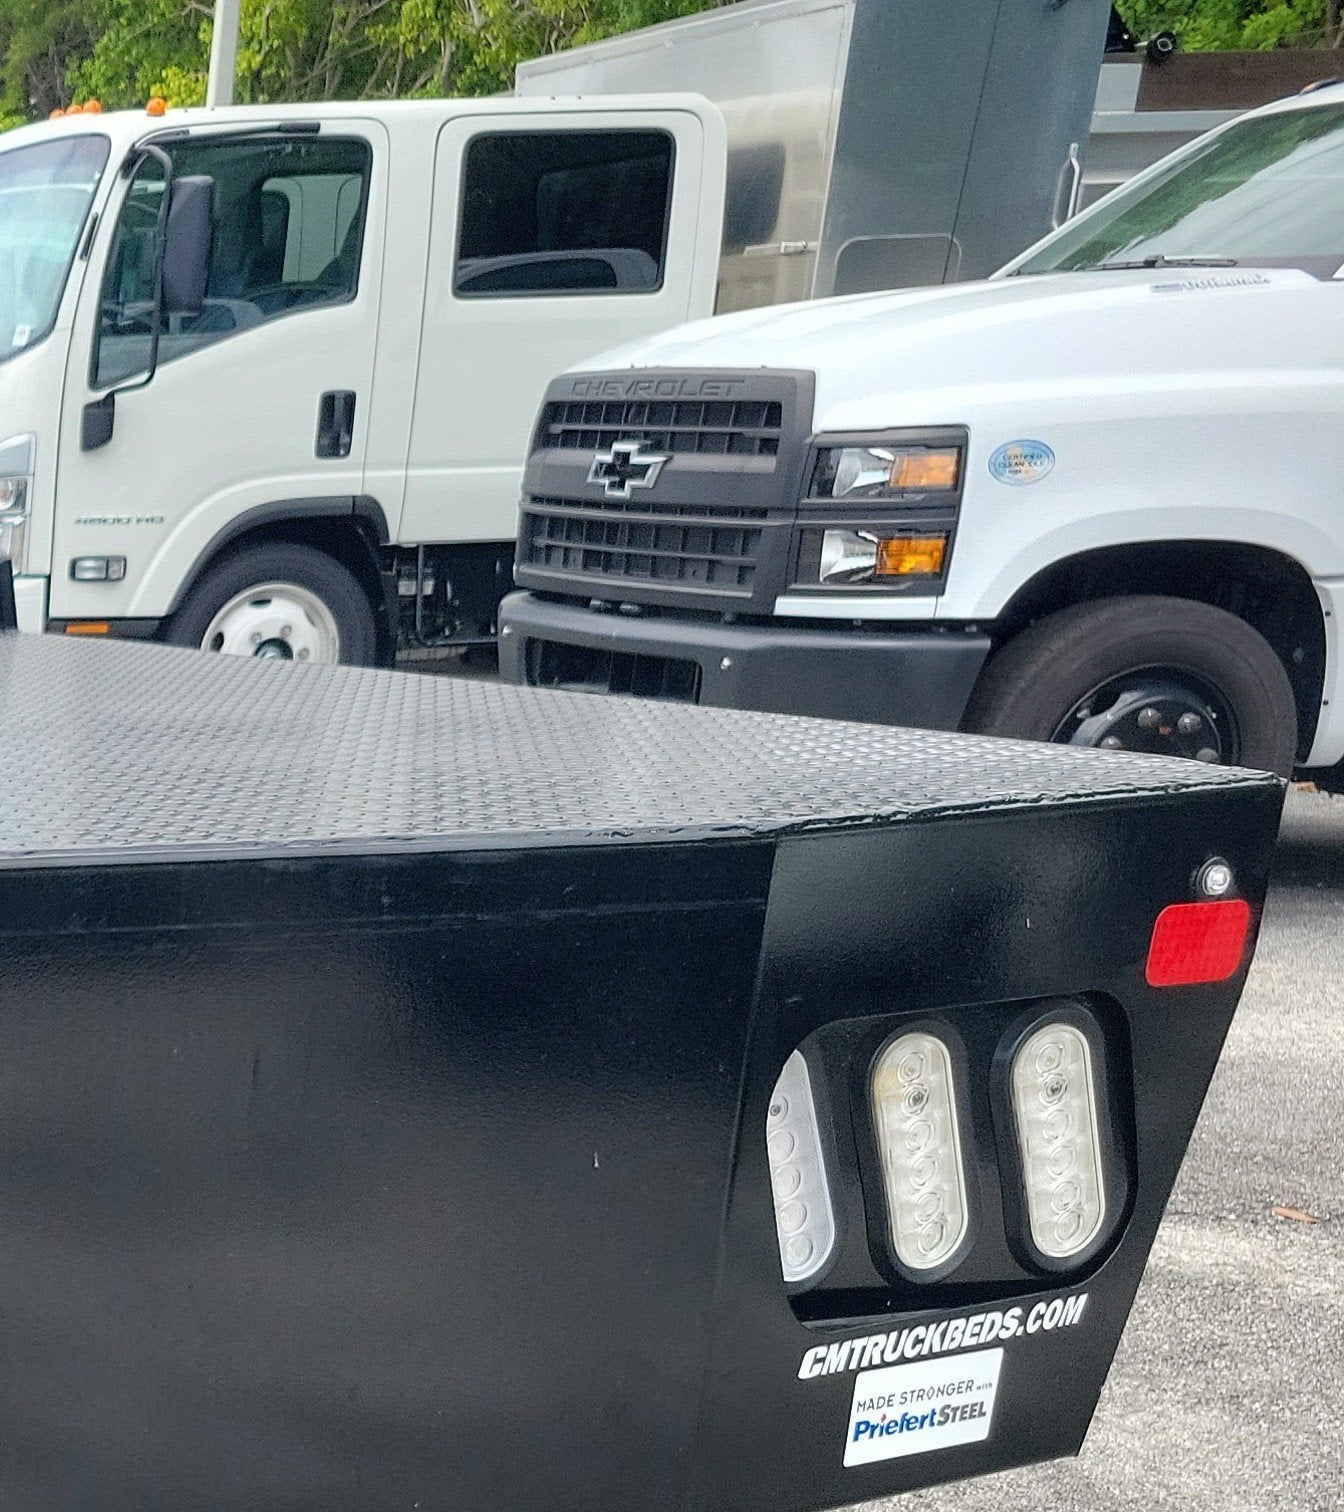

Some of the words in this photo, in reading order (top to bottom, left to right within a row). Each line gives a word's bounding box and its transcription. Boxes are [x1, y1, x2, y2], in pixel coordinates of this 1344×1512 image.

[572, 379, 745, 397] CHEVROLET
[798, 1293, 1089, 1380] CMTRUCKBEDS.COM
[856, 1394, 896, 1413] MADE
[899, 1379, 975, 1406] STRONGER
